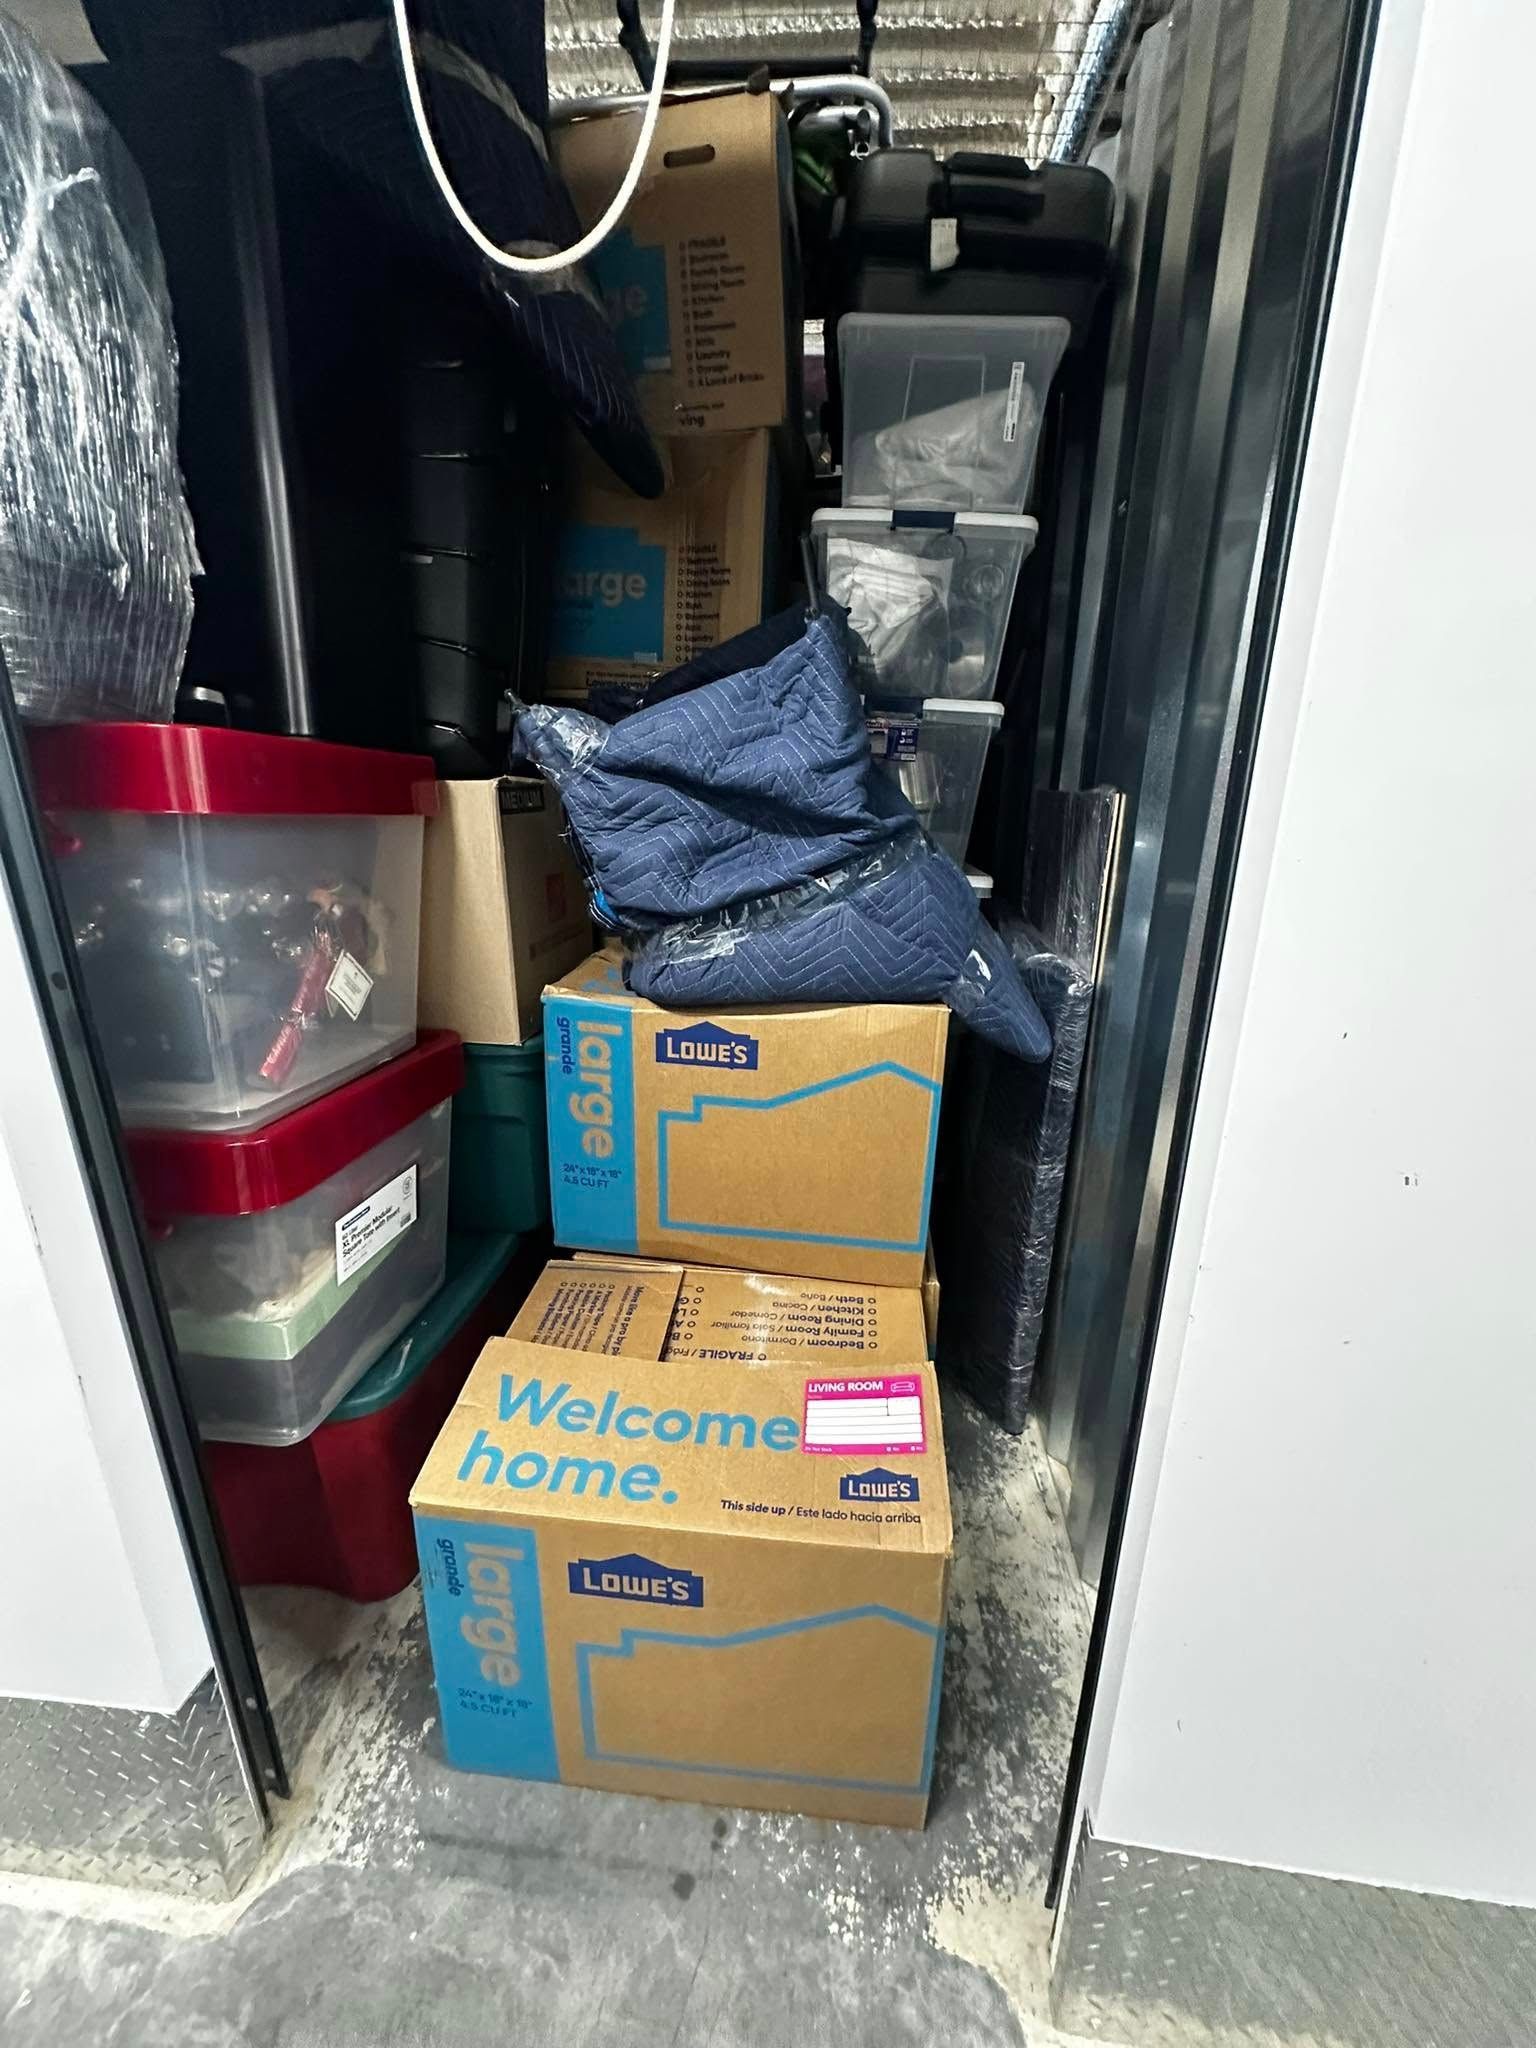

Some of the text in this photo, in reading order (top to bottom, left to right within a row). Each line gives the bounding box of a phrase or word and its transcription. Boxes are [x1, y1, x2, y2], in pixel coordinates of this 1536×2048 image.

[556, 1016, 576, 1076] grande
[666, 1036, 748, 1065] LOWE'S
[568, 1020, 623, 1159] large
[581, 1177, 595, 1188] CU
[597, 1179, 609, 1189] FT
[550, 1287, 563, 1307] Moving
[632, 1285, 644, 1303] Move
[835, 1295, 864, 1305] Bath
[627, 1303, 637, 1316] like
[772, 1301, 808, 1311] Cocina
[818, 1304, 864, 1316] Kitchen
[594, 1311, 603, 1326] Tape
[731, 1310, 778, 1320] Comedor
[788, 1313, 822, 1324] Room
[825, 1315, 864, 1327] Dining
[617, 1321, 629, 1335] pro
[710, 1321, 750, 1331] familiar
[752, 1323, 775, 1332] Sala
[785, 1325, 820, 1336] Room
[823, 1326, 864, 1338] Family
[615, 1335, 625, 1346] by
[807, 1339, 864, 1350] Bedroom
[698, 1348, 755, 1361] FRAGILE
[808, 1380, 884, 1393] LIVING ROOM
[498, 1373, 800, 1453] Welcome
[456, 1428, 679, 1504] home.
[848, 1479, 911, 1499] LOWE'S
[721, 1499, 921, 1524] This side up / Este lado hacia arriba
[436, 1538, 465, 1597] grande
[582, 1566, 690, 1601] LOWE'S
[460, 1541, 525, 1688] large
[480, 1703, 500, 1715] CU
